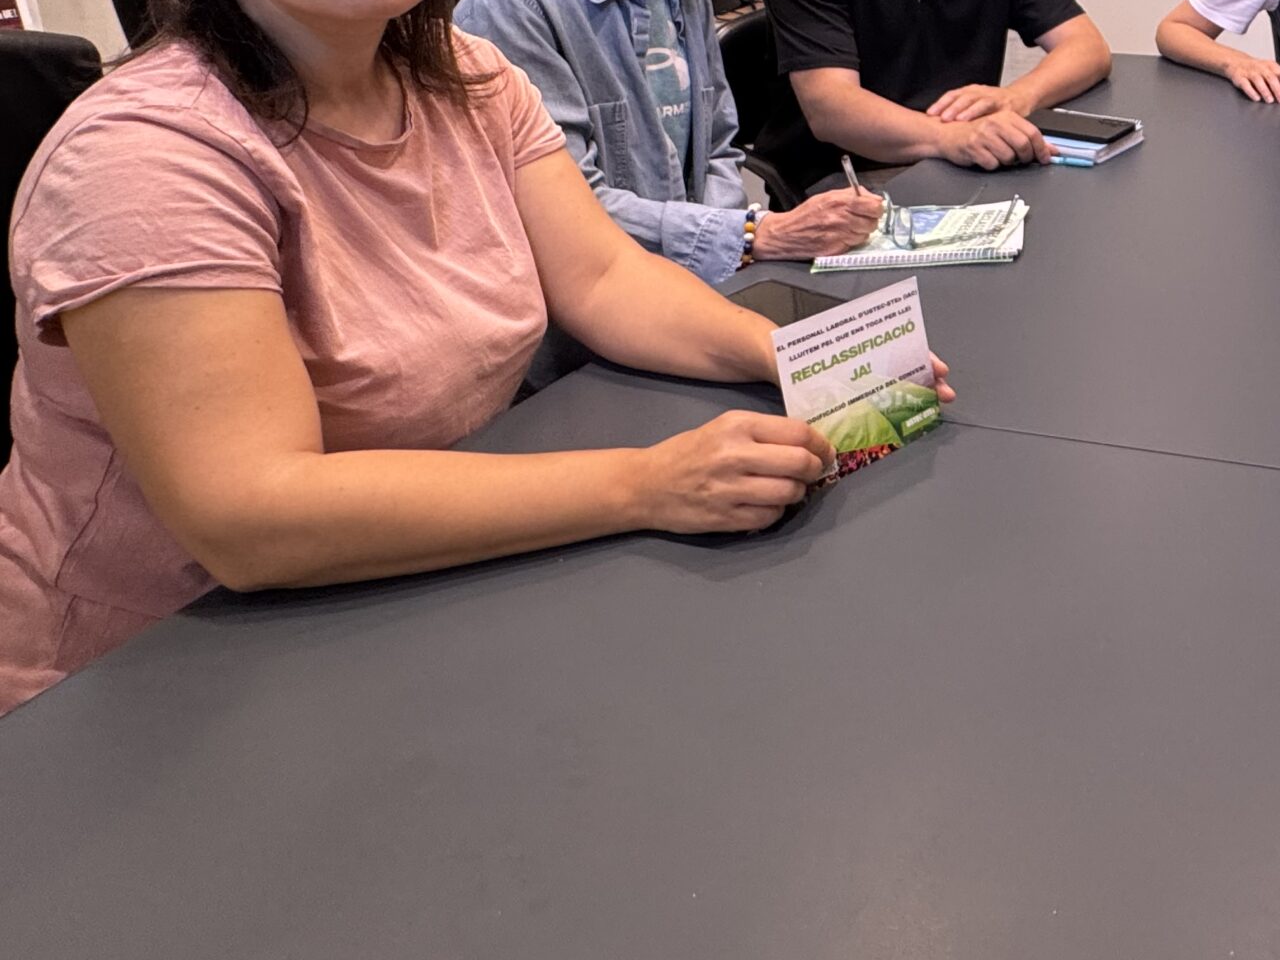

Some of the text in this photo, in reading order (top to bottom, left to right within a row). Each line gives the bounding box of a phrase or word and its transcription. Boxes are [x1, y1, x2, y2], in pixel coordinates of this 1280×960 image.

[787, 329, 824, 348] PERSONAL
[826, 316, 857, 331] LABORAL
[789, 345, 820, 362] LLUITEM
[821, 339, 834, 348] PEL
[835, 332, 850, 342] QUE
[851, 326, 864, 335] ENS
[865, 318, 883, 328] TOCA
[884, 312, 897, 321] PER
[790, 318, 916, 384] RECLASSIFICACIÓ
[850, 362, 872, 381] JA!
[806, 401, 847, 425] ODIFICACIÓ
[885, 379, 898, 388] DEL
